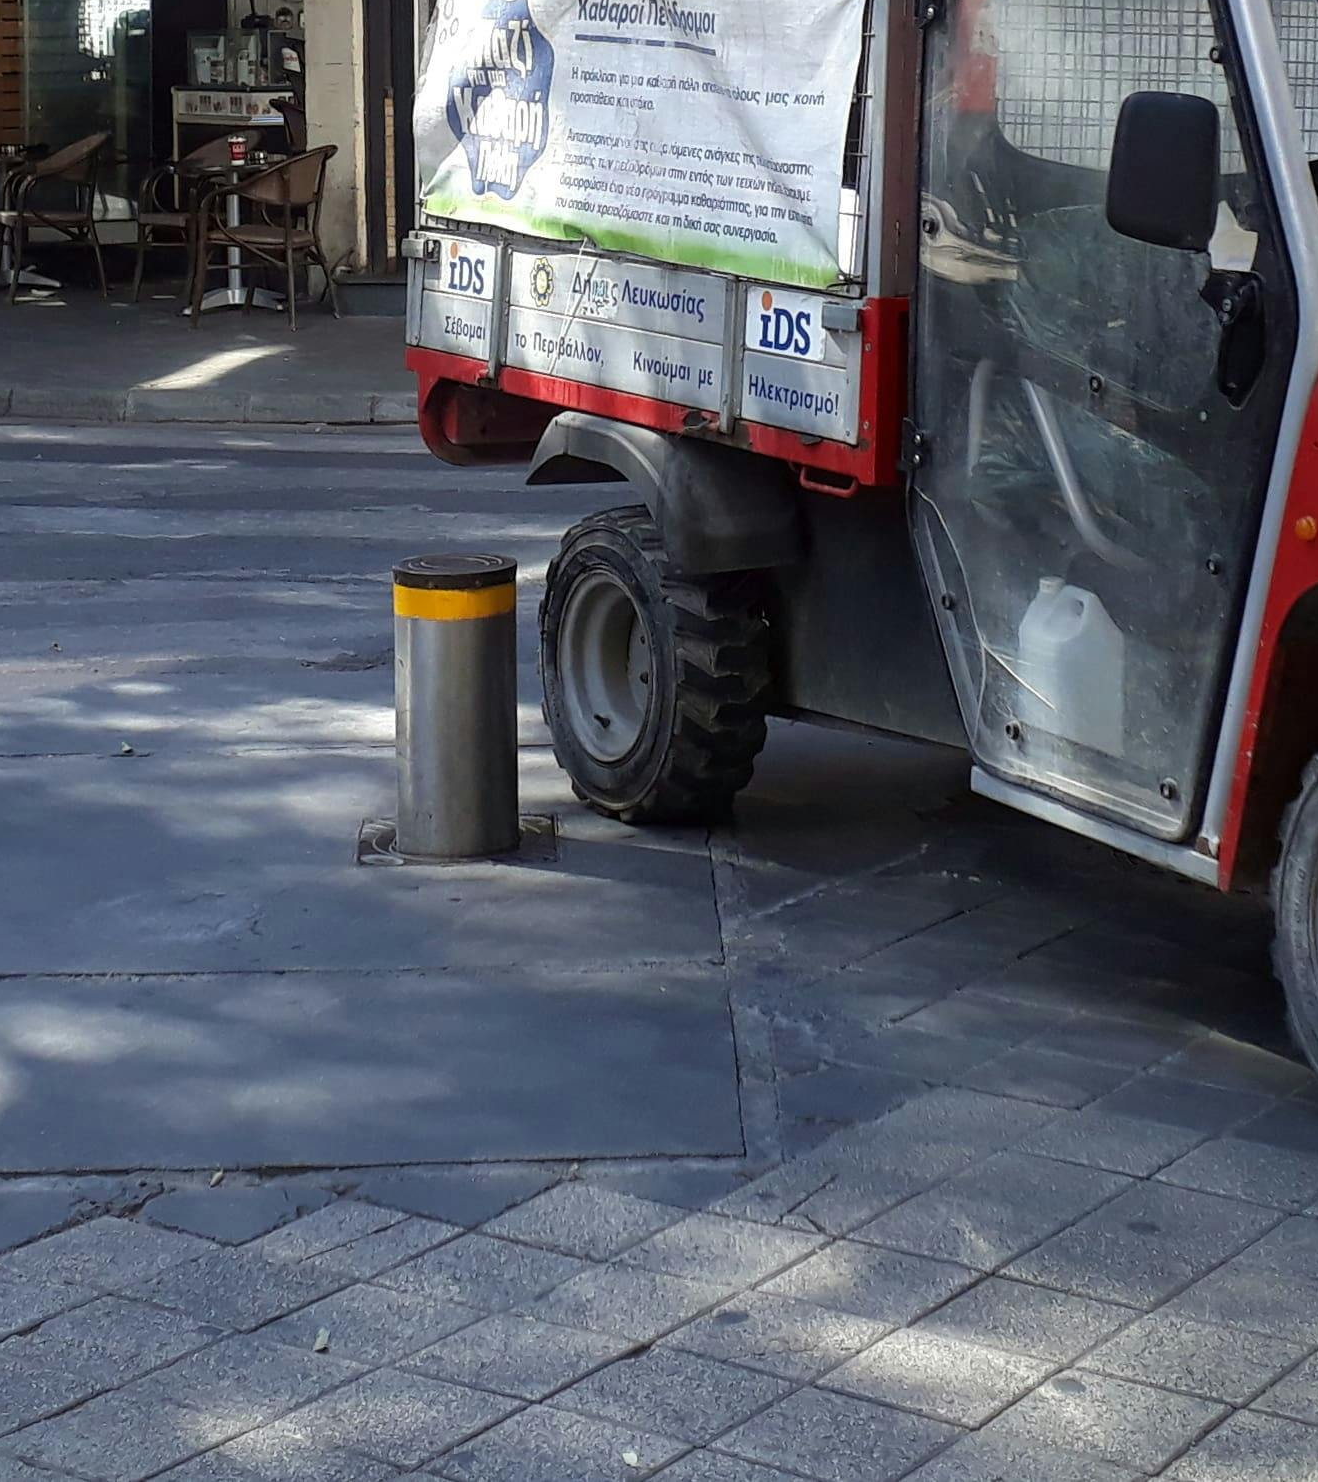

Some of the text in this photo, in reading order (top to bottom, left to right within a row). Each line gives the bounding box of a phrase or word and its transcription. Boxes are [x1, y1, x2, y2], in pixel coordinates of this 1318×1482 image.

[764, 89, 790, 105] μας
[793, 89, 826, 106] κοινή
[655, 214, 670, 226] και
[703, 221, 720, 236] σας
[722, 224, 778, 245] συνεργασία.
[621, 288, 704, 322] Λευκωσίας
[444, 315, 486, 341] Σέβομαι
[514, 333, 528, 349] το
[633, 350, 839, 417] Κινούμαι με Ηλεκτρισμό!
